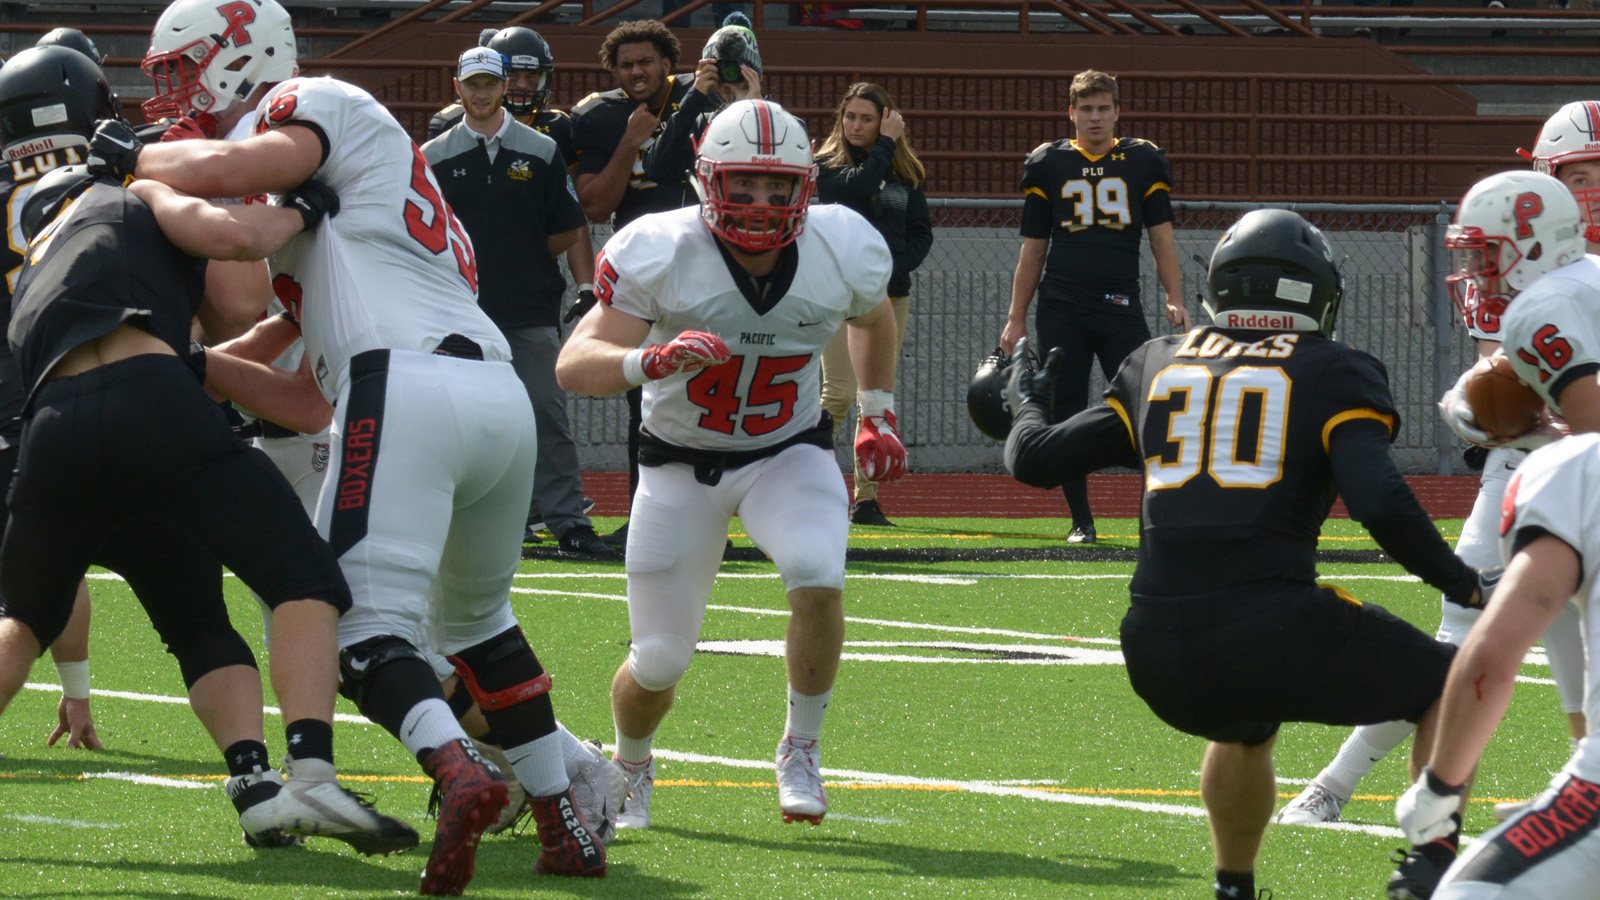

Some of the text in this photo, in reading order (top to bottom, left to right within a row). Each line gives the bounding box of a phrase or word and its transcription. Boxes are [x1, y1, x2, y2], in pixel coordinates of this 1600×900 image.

[9, 138, 54, 160] Riddell
[1584, 143, 1600, 151] Rid
[1082, 167, 1104, 177] PLU
[1061, 177, 1132, 233] 39
[1513, 191, 1544, 240] P
[739, 331, 777, 346] PACIFIC
[1174, 328, 1299, 358] LUTES
[1228, 314, 1294, 329] Riddell
[1516, 323, 1573, 383] 16
[686, 353, 812, 436] 45
[1144, 364, 1292, 492] 30
[338, 418, 377, 511] BOXERS
[559, 797, 596, 857] ARMOUR
